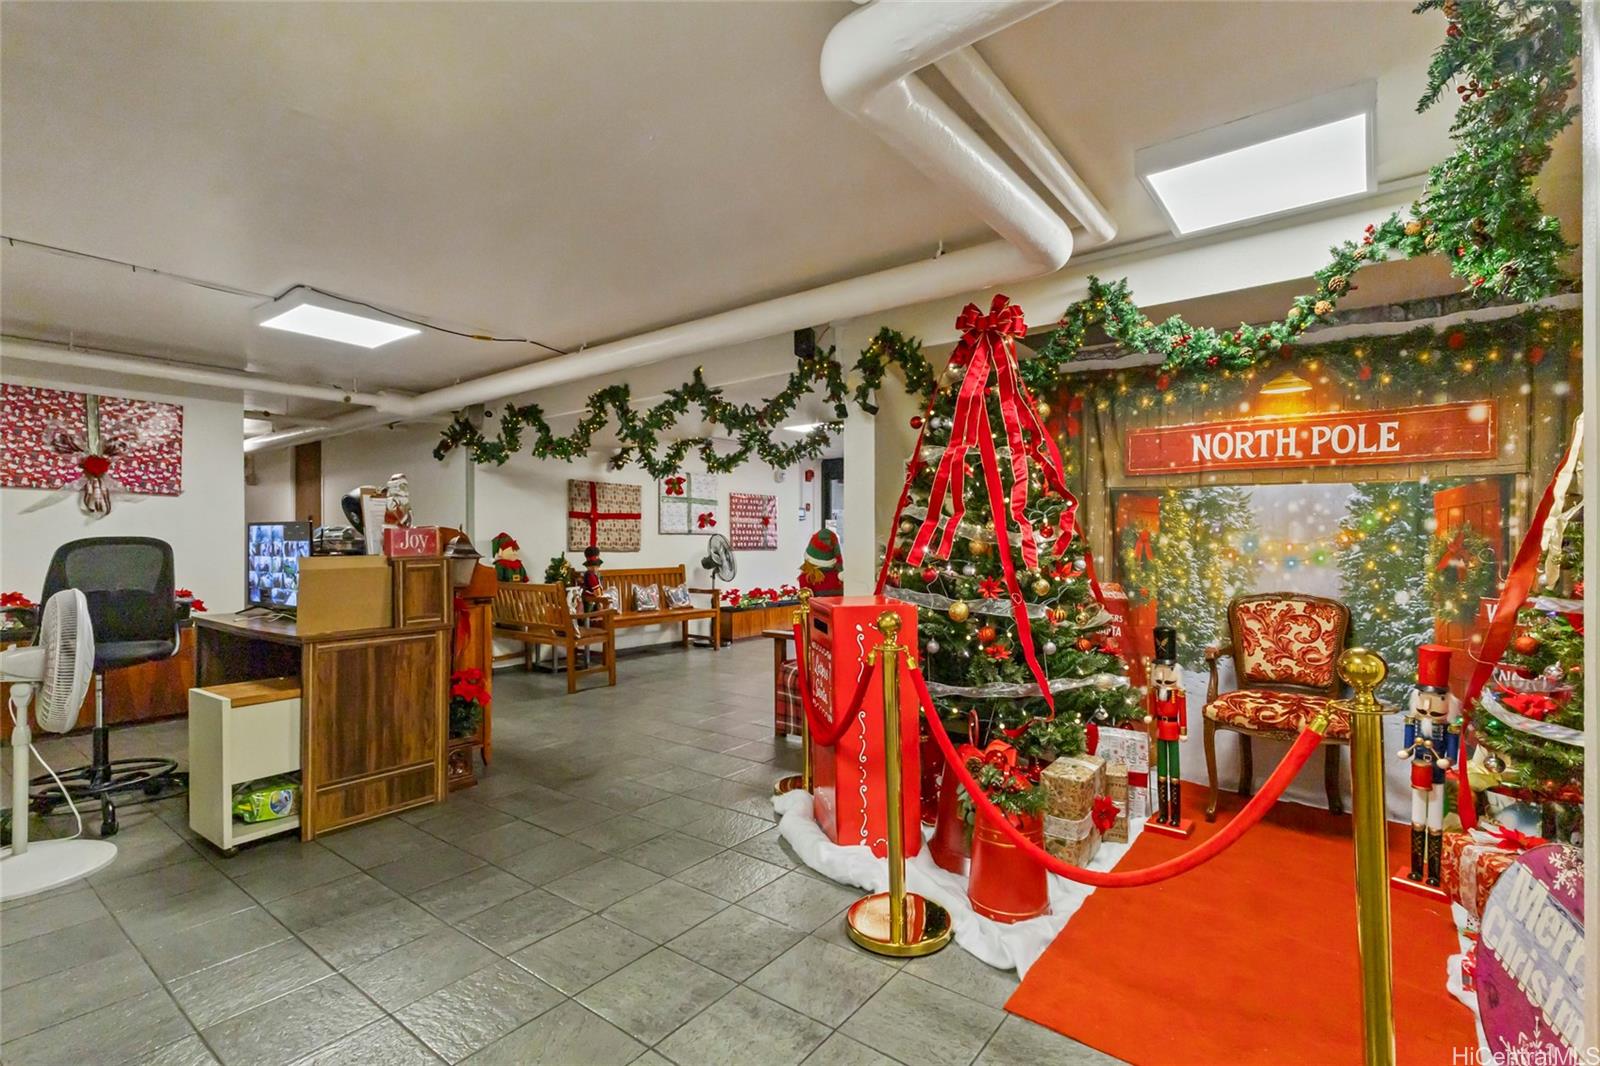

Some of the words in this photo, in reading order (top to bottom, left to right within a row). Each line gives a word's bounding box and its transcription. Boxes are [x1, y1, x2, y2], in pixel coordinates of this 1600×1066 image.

[1192, 427, 1297, 462] NORTH
[1311, 421, 1400, 455] POLE
[400, 530, 428, 553] Joy
[1507, 863, 1584, 988] Merr
[1481, 906, 1584, 1052] Christm
